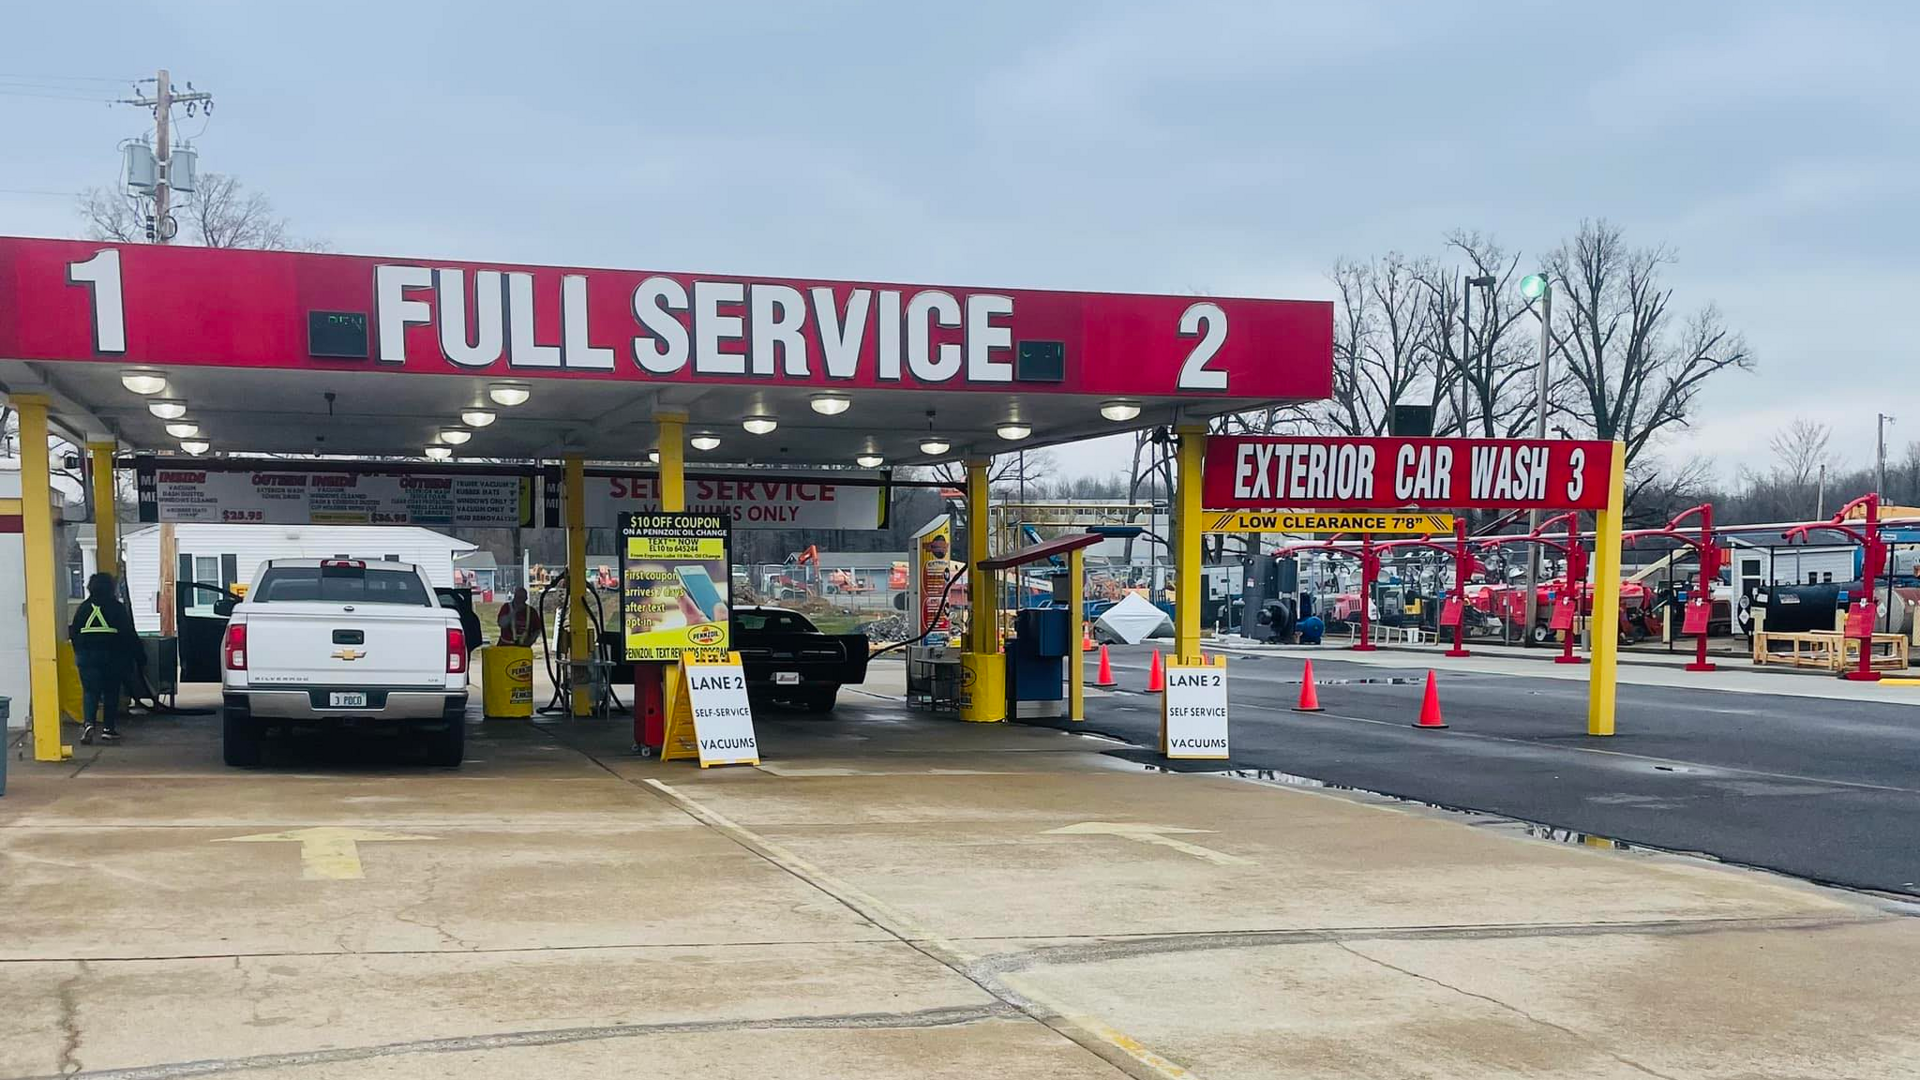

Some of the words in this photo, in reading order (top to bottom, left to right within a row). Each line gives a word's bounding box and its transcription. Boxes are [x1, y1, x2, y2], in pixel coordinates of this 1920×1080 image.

[67, 248, 126, 354] 1
[375, 264, 615, 370] FULL
[632, 276, 1014, 382] SERVICE
[1177, 302, 1229, 391] 2
[1234, 443, 1376, 500] EXTERIOR
[1395, 443, 1453, 500] CAR
[1470, 445, 1549, 500] WASH
[1567, 447, 1586, 501] 3
[609, 477, 660, 499] SEL
[697, 481, 835, 502] SERVICE
[222, 510, 263, 521] $25.95
[748, 504, 800, 522] ONLY
[630, 516, 650, 529] $10
[652, 516, 673, 528] OFF
[674, 517, 720, 529] COUPON
[1239, 516, 1277, 529] LOW
[1283, 516, 1386, 529] CLEARANCE
[622, 528, 635, 536] ON
[635, 528, 643, 536] A
[682, 529, 695, 537] OIL
[695, 529, 728, 537] CHANGE
[625, 570, 644, 581] First
[645, 571, 679, 583] coupon
[625, 586, 655, 598] arrives
[663, 586, 685, 600] days
[625, 602, 646, 612] after
[647, 603, 666, 613] text
[656, 647, 670, 659] TEXT
[691, 676, 731, 690] LANE
[734, 676, 744, 689] 2
[1170, 675, 1208, 687] LANE
[1212, 675, 1220, 687] 2
[695, 707, 749, 718] SELF-SERVICE
[700, 738, 755, 750] VACUUMS
[1171, 739, 1227, 748] VACUUMS
